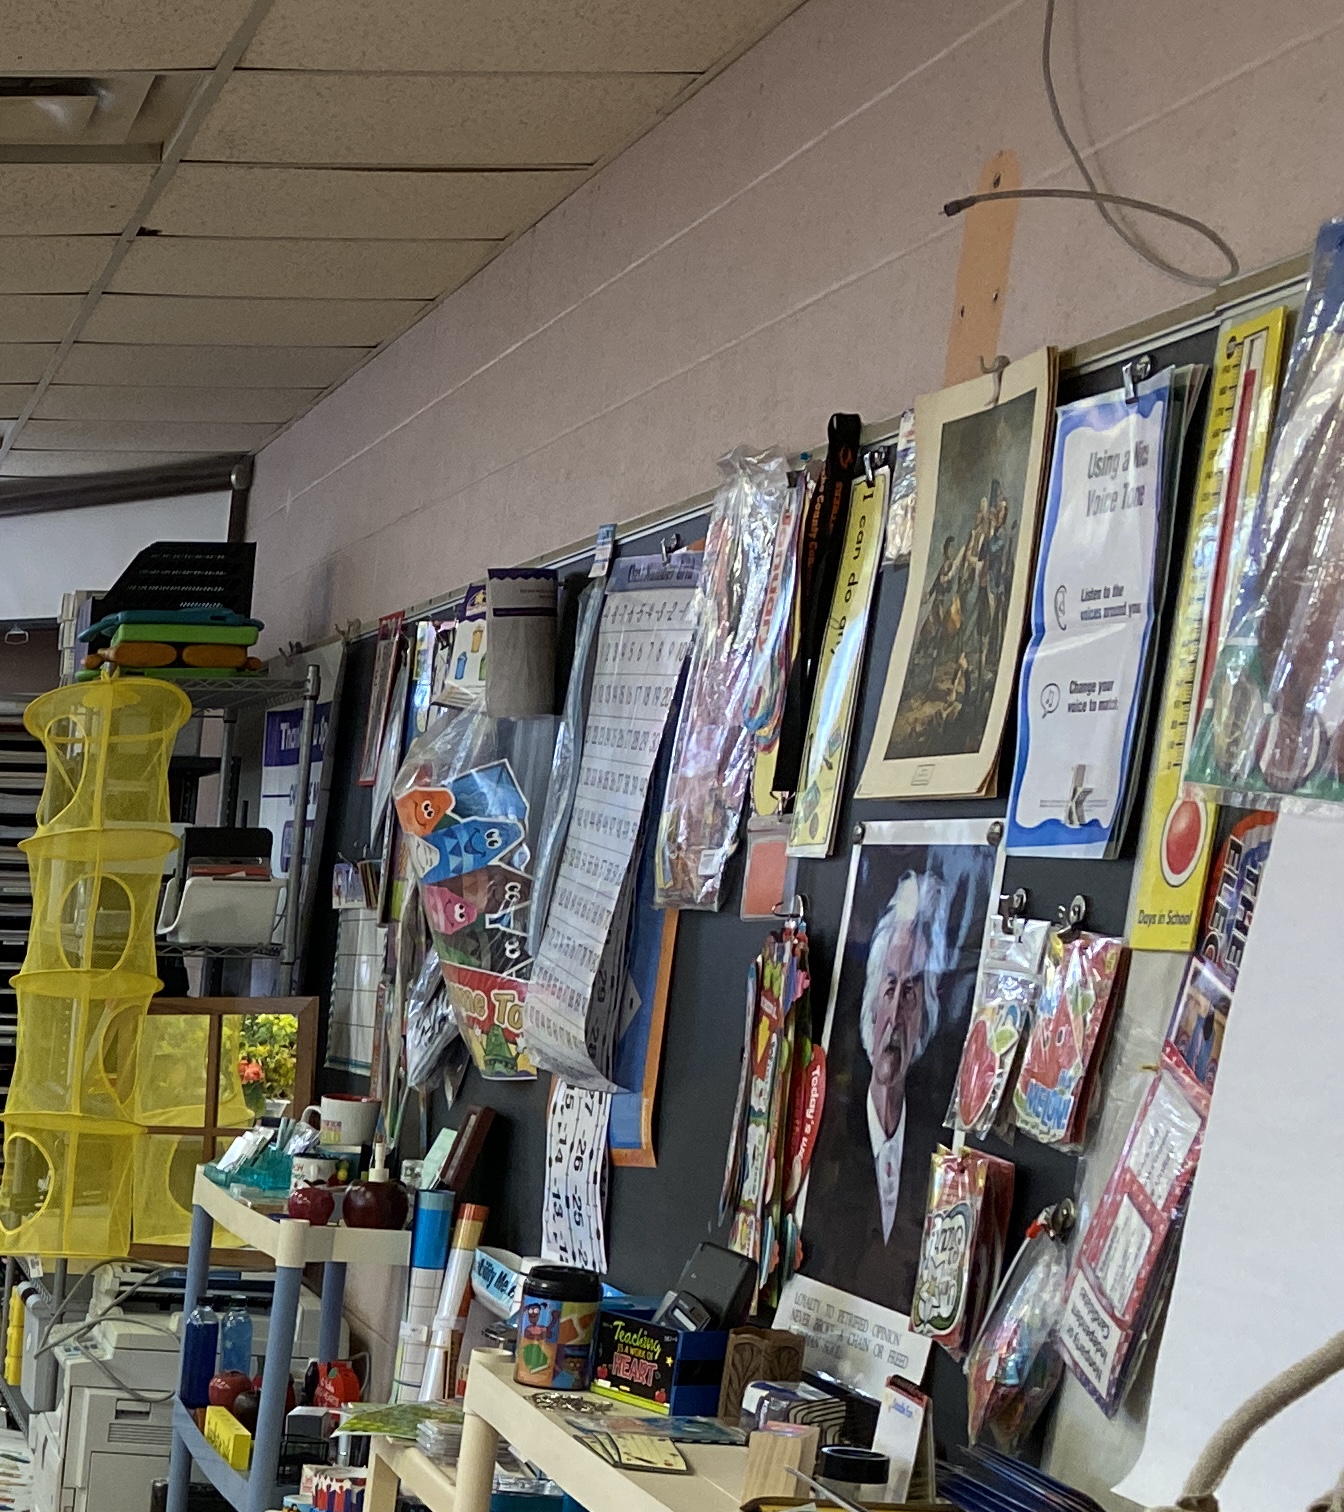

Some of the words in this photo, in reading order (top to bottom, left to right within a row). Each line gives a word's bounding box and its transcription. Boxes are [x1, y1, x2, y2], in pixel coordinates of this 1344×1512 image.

[1088, 450, 1120, 481] Using
[1122, 450, 1131, 471] a
[851, 516, 869, 561] can
[756, 507, 794, 654] January
[844, 577, 859, 605] do
[1138, 909, 1157, 928] Days
[1157, 910, 1165, 925] in
[1166, 909, 1194, 926] School
[803, 1064, 821, 1134] Today's
[555, 1123, 567, 1164] -14
[574, 1129, 586, 1172] -26
[552, 1177, 563, 1218] -13
[572, 1184, 584, 1227] -25
[577, 1240, 589, 1267] -2
[794, 1291, 820, 1317] LOYALTY
[825, 1304, 834, 1319] TO
[872, 1323, 902, 1347] OPINION
[613, 1320, 662, 1360] Teaching
[847, 1333, 869, 1352] CHAIN
[873, 1343, 883, 1360] OR
[611, 1351, 658, 1387] HEART
